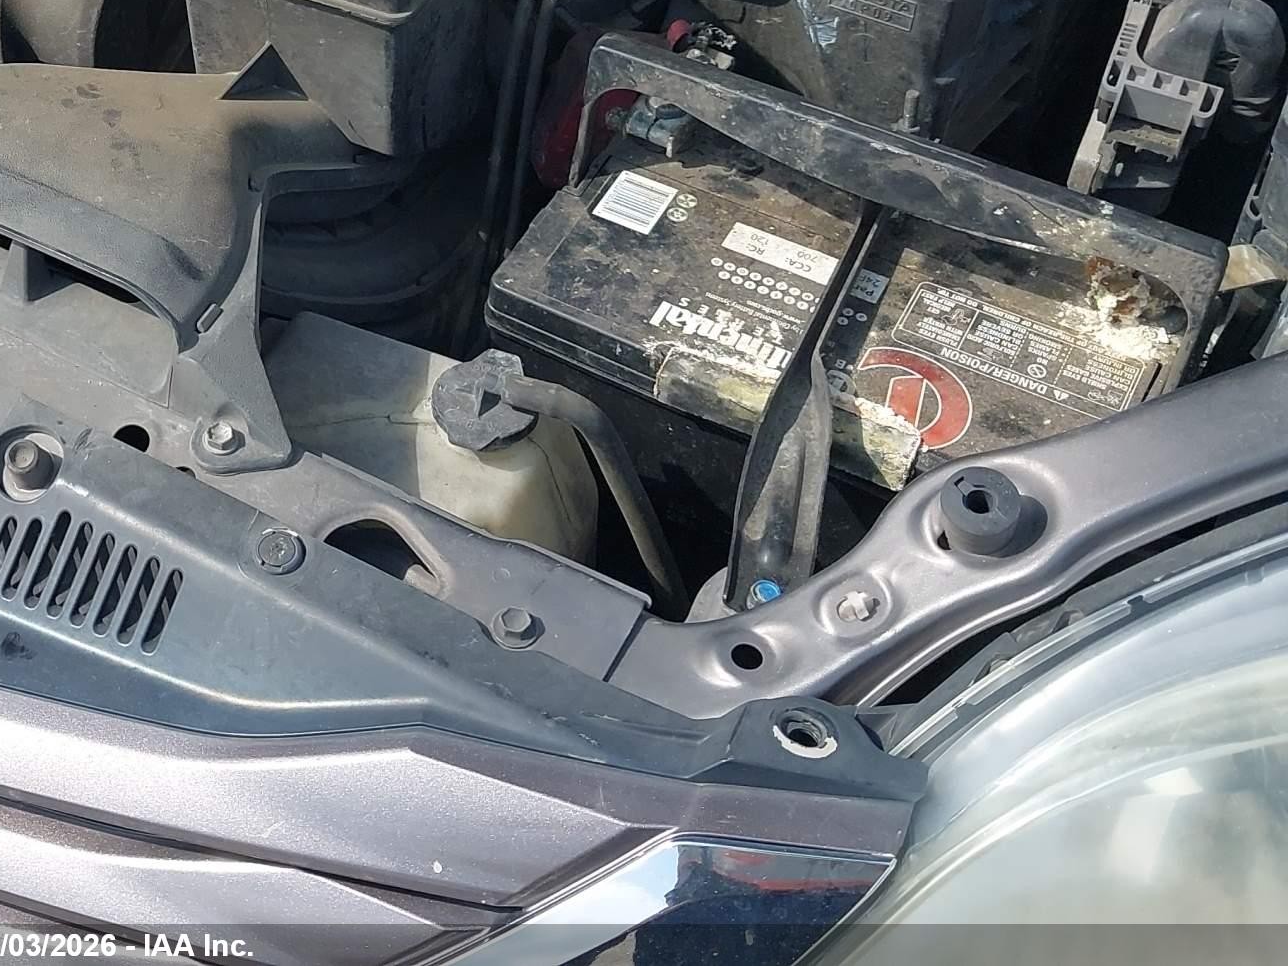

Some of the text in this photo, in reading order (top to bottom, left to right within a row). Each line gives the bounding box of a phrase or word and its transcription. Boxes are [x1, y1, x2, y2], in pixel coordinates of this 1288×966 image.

[749, 232, 817, 262] 700 120
[743, 242, 812, 273] CCA: RC:
[704, 291, 730, 305] Systems
[920, 290, 955, 308] HELP FAST
[922, 296, 950, 312] MEDICAL
[949, 291, 965, 302] NOT
[965, 298, 977, 307] DO
[729, 300, 754, 315] Battery
[926, 305, 940, 315] GET
[980, 303, 1020, 324] CHILDREN.
[916, 319, 960, 342] IMMEDIATELY
[922, 315, 963, 336] WITH WATER
[980, 318, 1023, 340] OR SEVERE
[998, 319, 1026, 334] BURNS
[1019, 318, 1031, 328] OF
[1031, 322, 1058, 338] REACH
[917, 326, 957, 346] FLUSH EYES
[974, 328, 1018, 350] CAN CAUSE
[976, 323, 1021, 345] BLINDNESS
[1027, 332, 1061, 351] SMOKING
[1026, 345, 1057, 361] SPARKS
[1028, 339, 1059, 356] FLAMES
[939, 344, 1048, 395] DANGER/POISON
[1035, 356, 1048, 365] NO
[1086, 357, 1133, 380] BLINDNESS
[1091, 352, 1122, 370] INJURY
[1061, 368, 1080, 380] EYES
[1065, 363, 1128, 391] EXPLOSIVE GASES
[1084, 363, 1130, 386] CAN CAUSE
